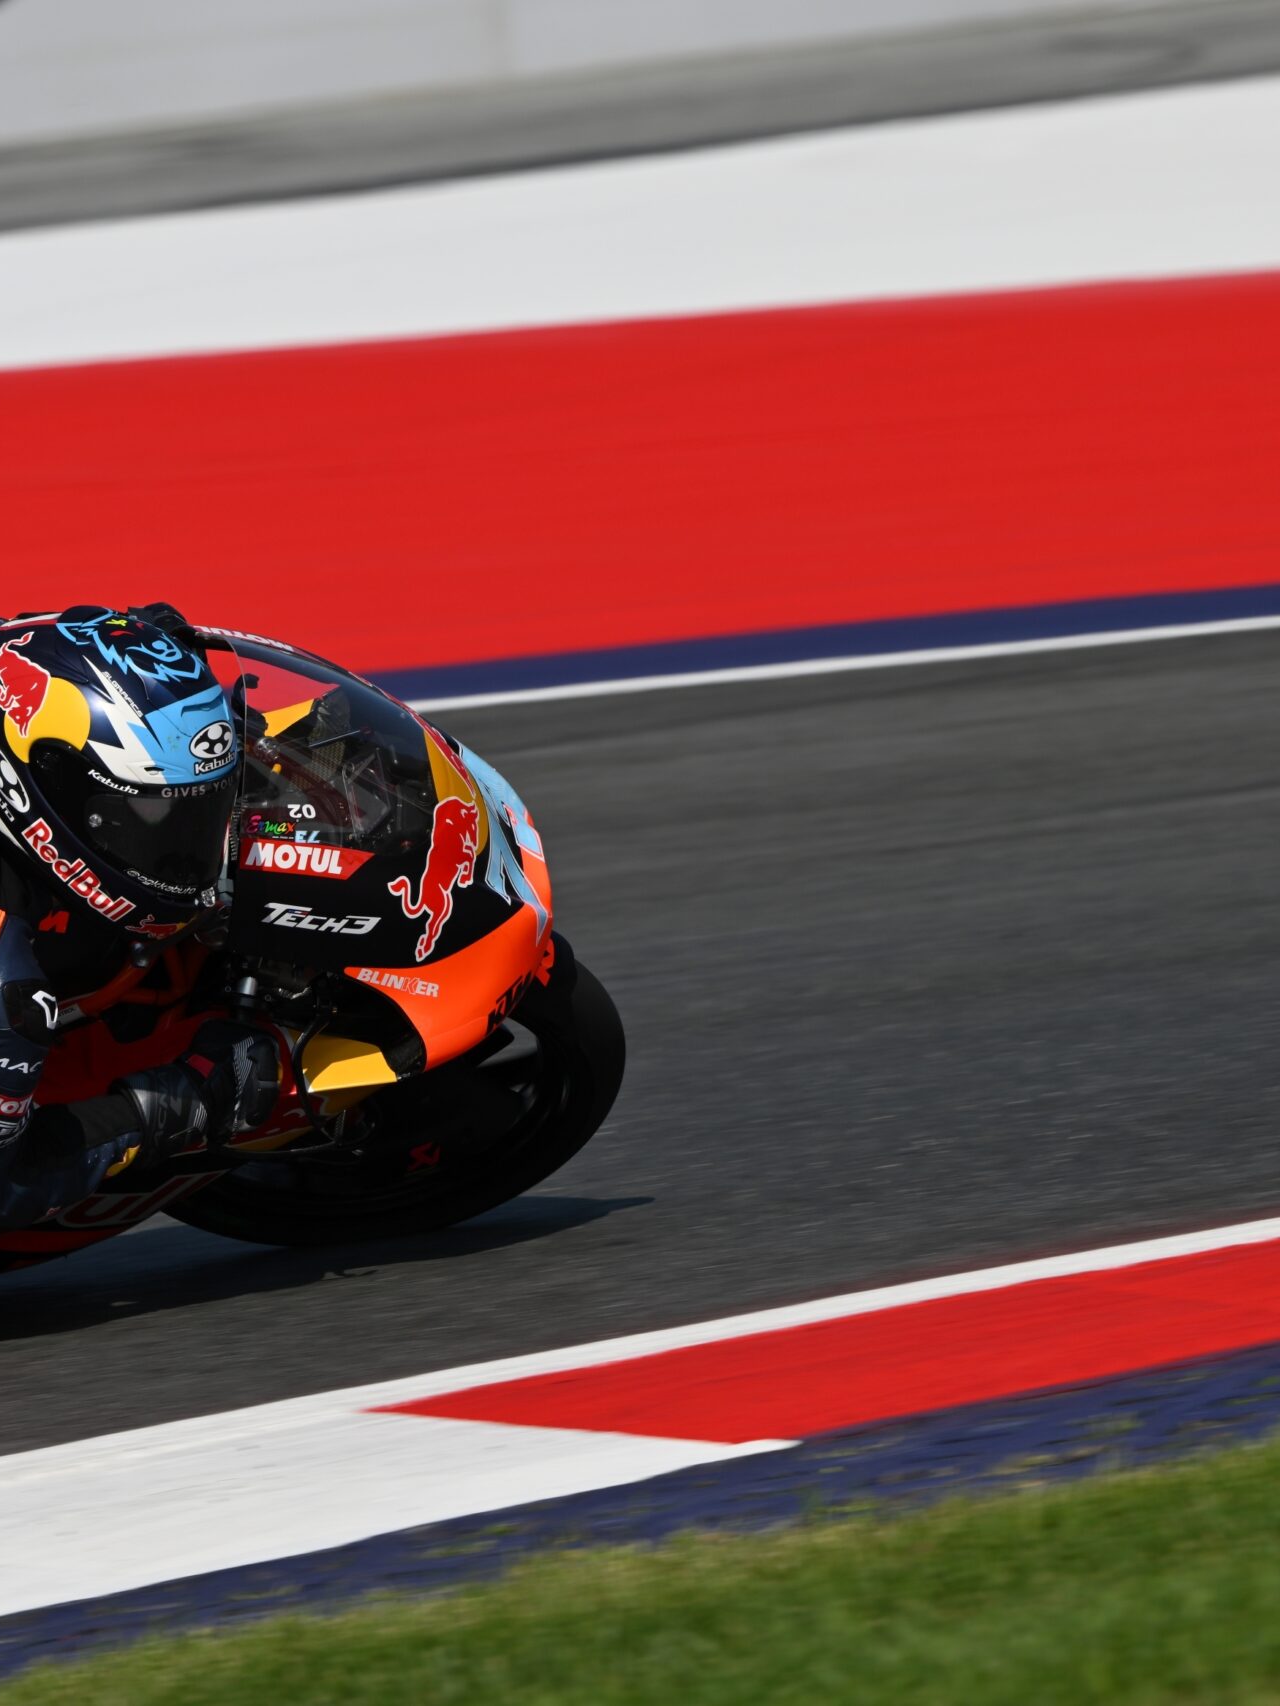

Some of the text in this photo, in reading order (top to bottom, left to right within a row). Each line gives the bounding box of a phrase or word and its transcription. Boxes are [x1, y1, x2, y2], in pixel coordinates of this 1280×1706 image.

[87, 769, 139, 795] Kabuto
[161, 784, 206, 799] GIVES
[21, 818, 83, 882] Red
[68, 867, 137, 922] Bull
[245, 842, 343, 875] MOTUL
[261, 902, 381, 935] TECH3
[357, 967, 440, 998] BLINKER
